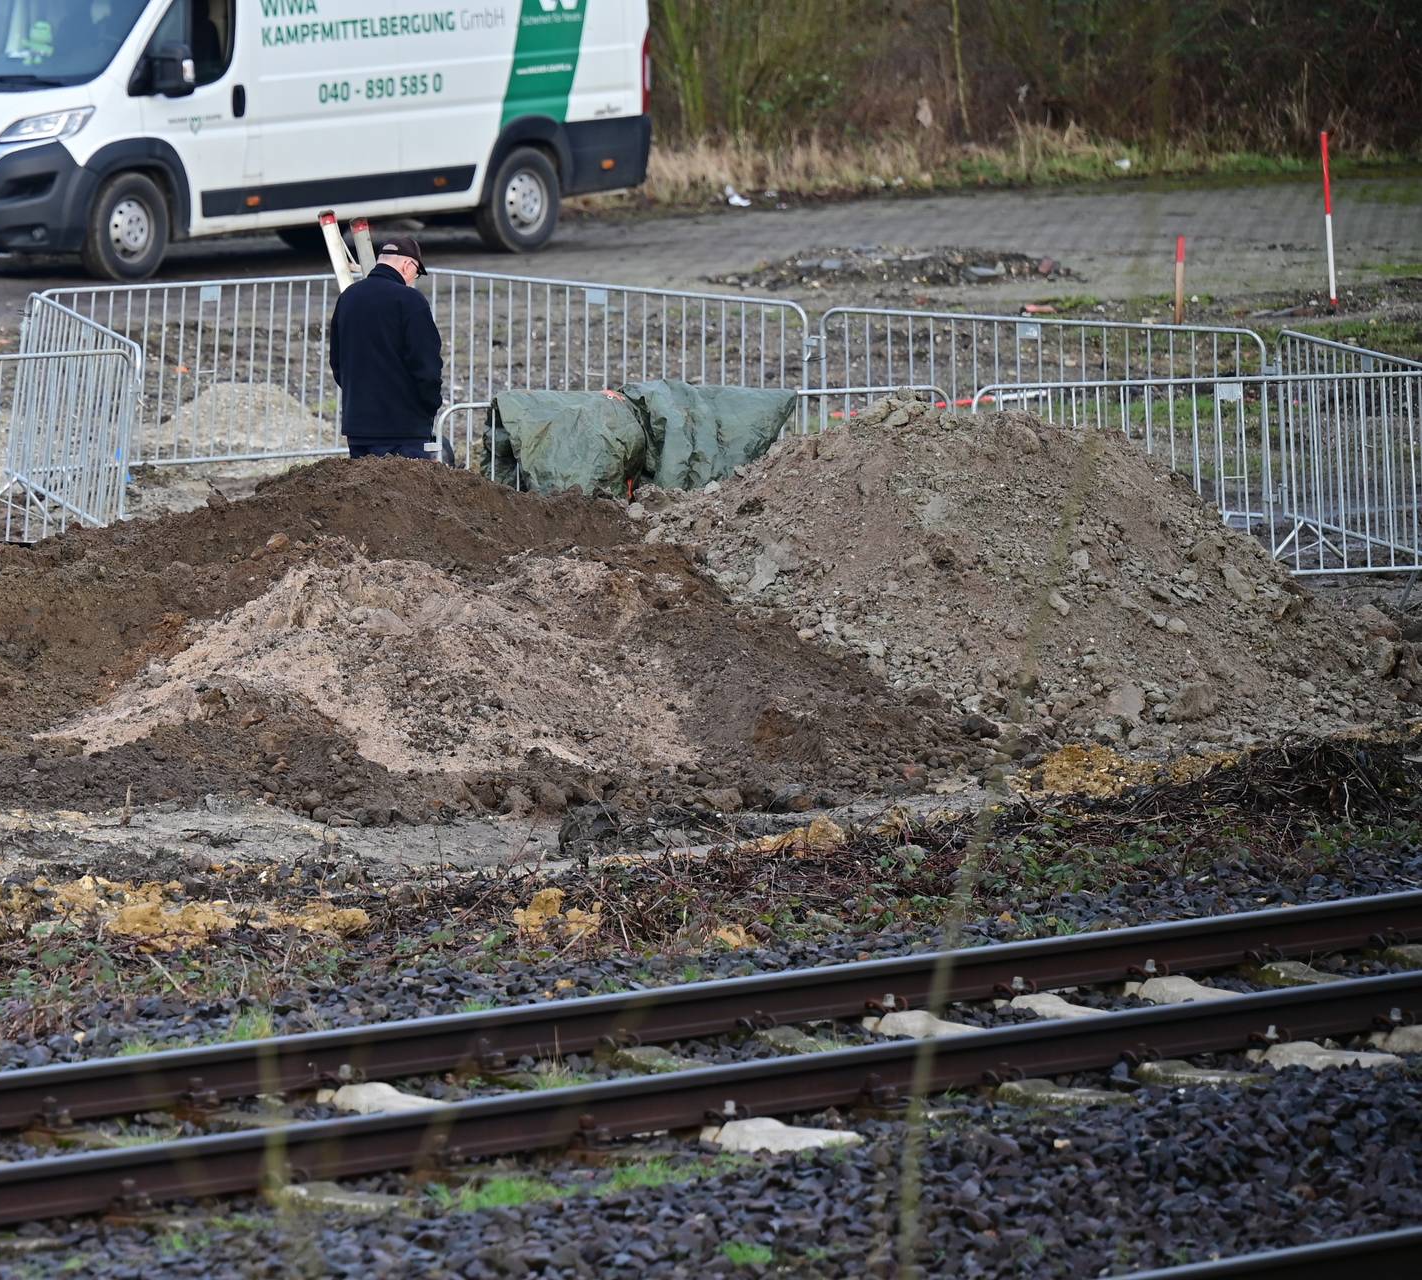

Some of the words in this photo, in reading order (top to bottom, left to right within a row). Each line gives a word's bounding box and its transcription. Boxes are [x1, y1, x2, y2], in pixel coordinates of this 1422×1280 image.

[261, 11, 455, 47] KAMPFMITTELBERGUNG
[460, 8, 505, 31] GmbH
[318, 82, 350, 103] 040
[365, 77, 395, 100] 890
[400, 74, 428, 96] 585
[433, 73, 443, 93] 0
